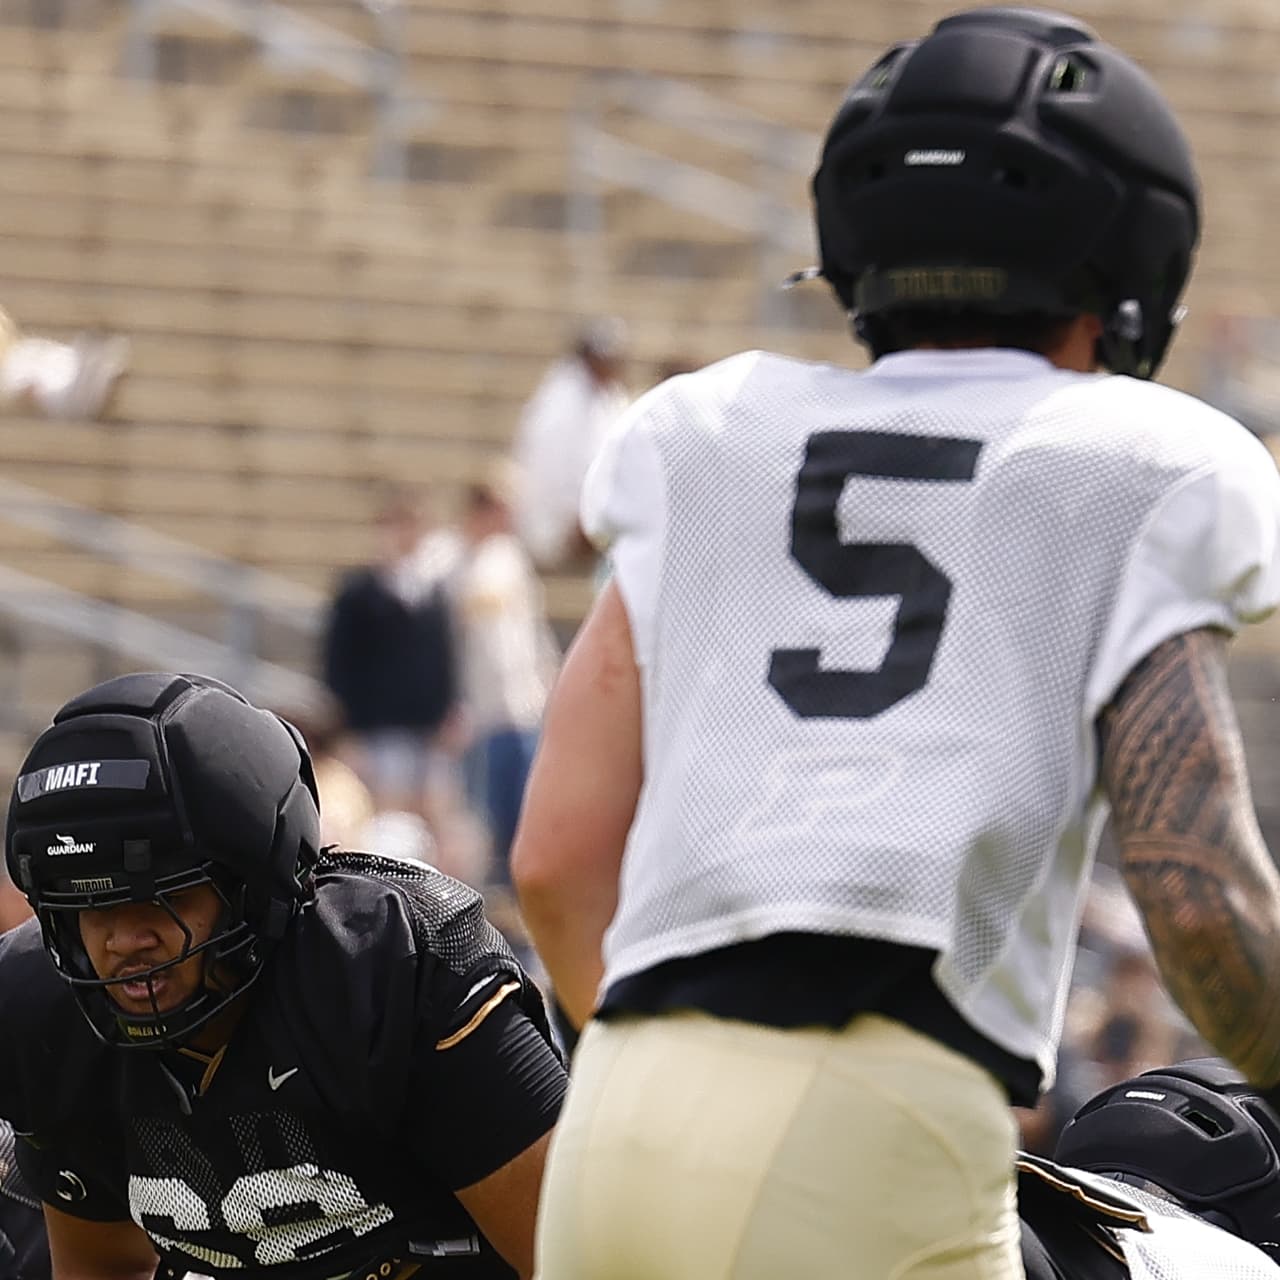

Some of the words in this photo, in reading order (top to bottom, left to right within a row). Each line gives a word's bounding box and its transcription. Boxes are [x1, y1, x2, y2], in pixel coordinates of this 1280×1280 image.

[767, 430, 983, 719] 5
[45, 763, 101, 792] MAFI
[47, 843, 93, 856] GUARDIAN
